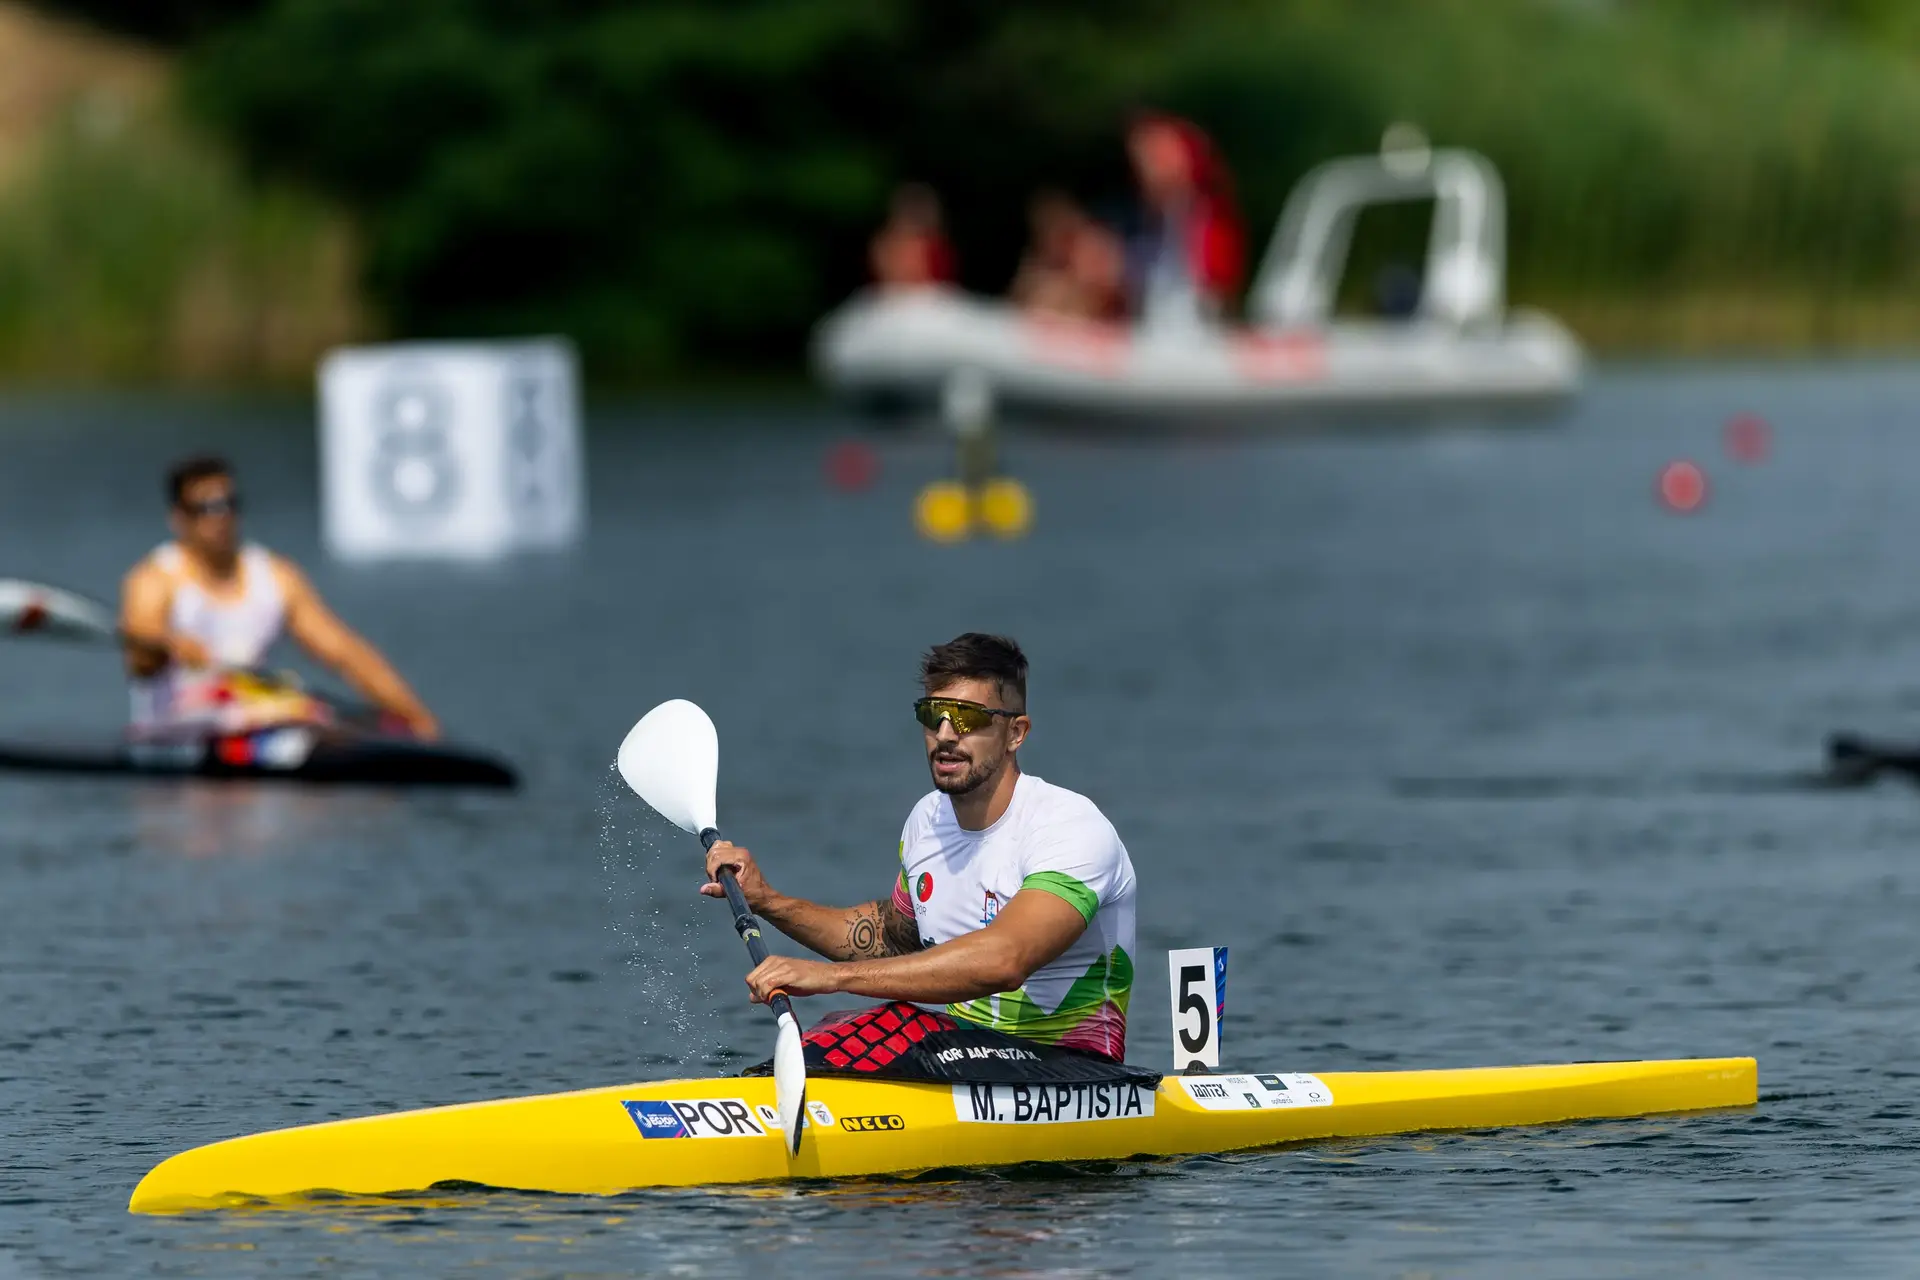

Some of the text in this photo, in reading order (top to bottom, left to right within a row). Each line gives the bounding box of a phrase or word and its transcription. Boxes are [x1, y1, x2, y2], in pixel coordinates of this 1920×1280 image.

[367, 376, 461, 518] 8
[1178, 965, 1210, 1054] 5
[671, 1101, 763, 1136] POR
[969, 1082, 1142, 1122] M. BAPTISTA
[842, 1115, 903, 1132] NELO
